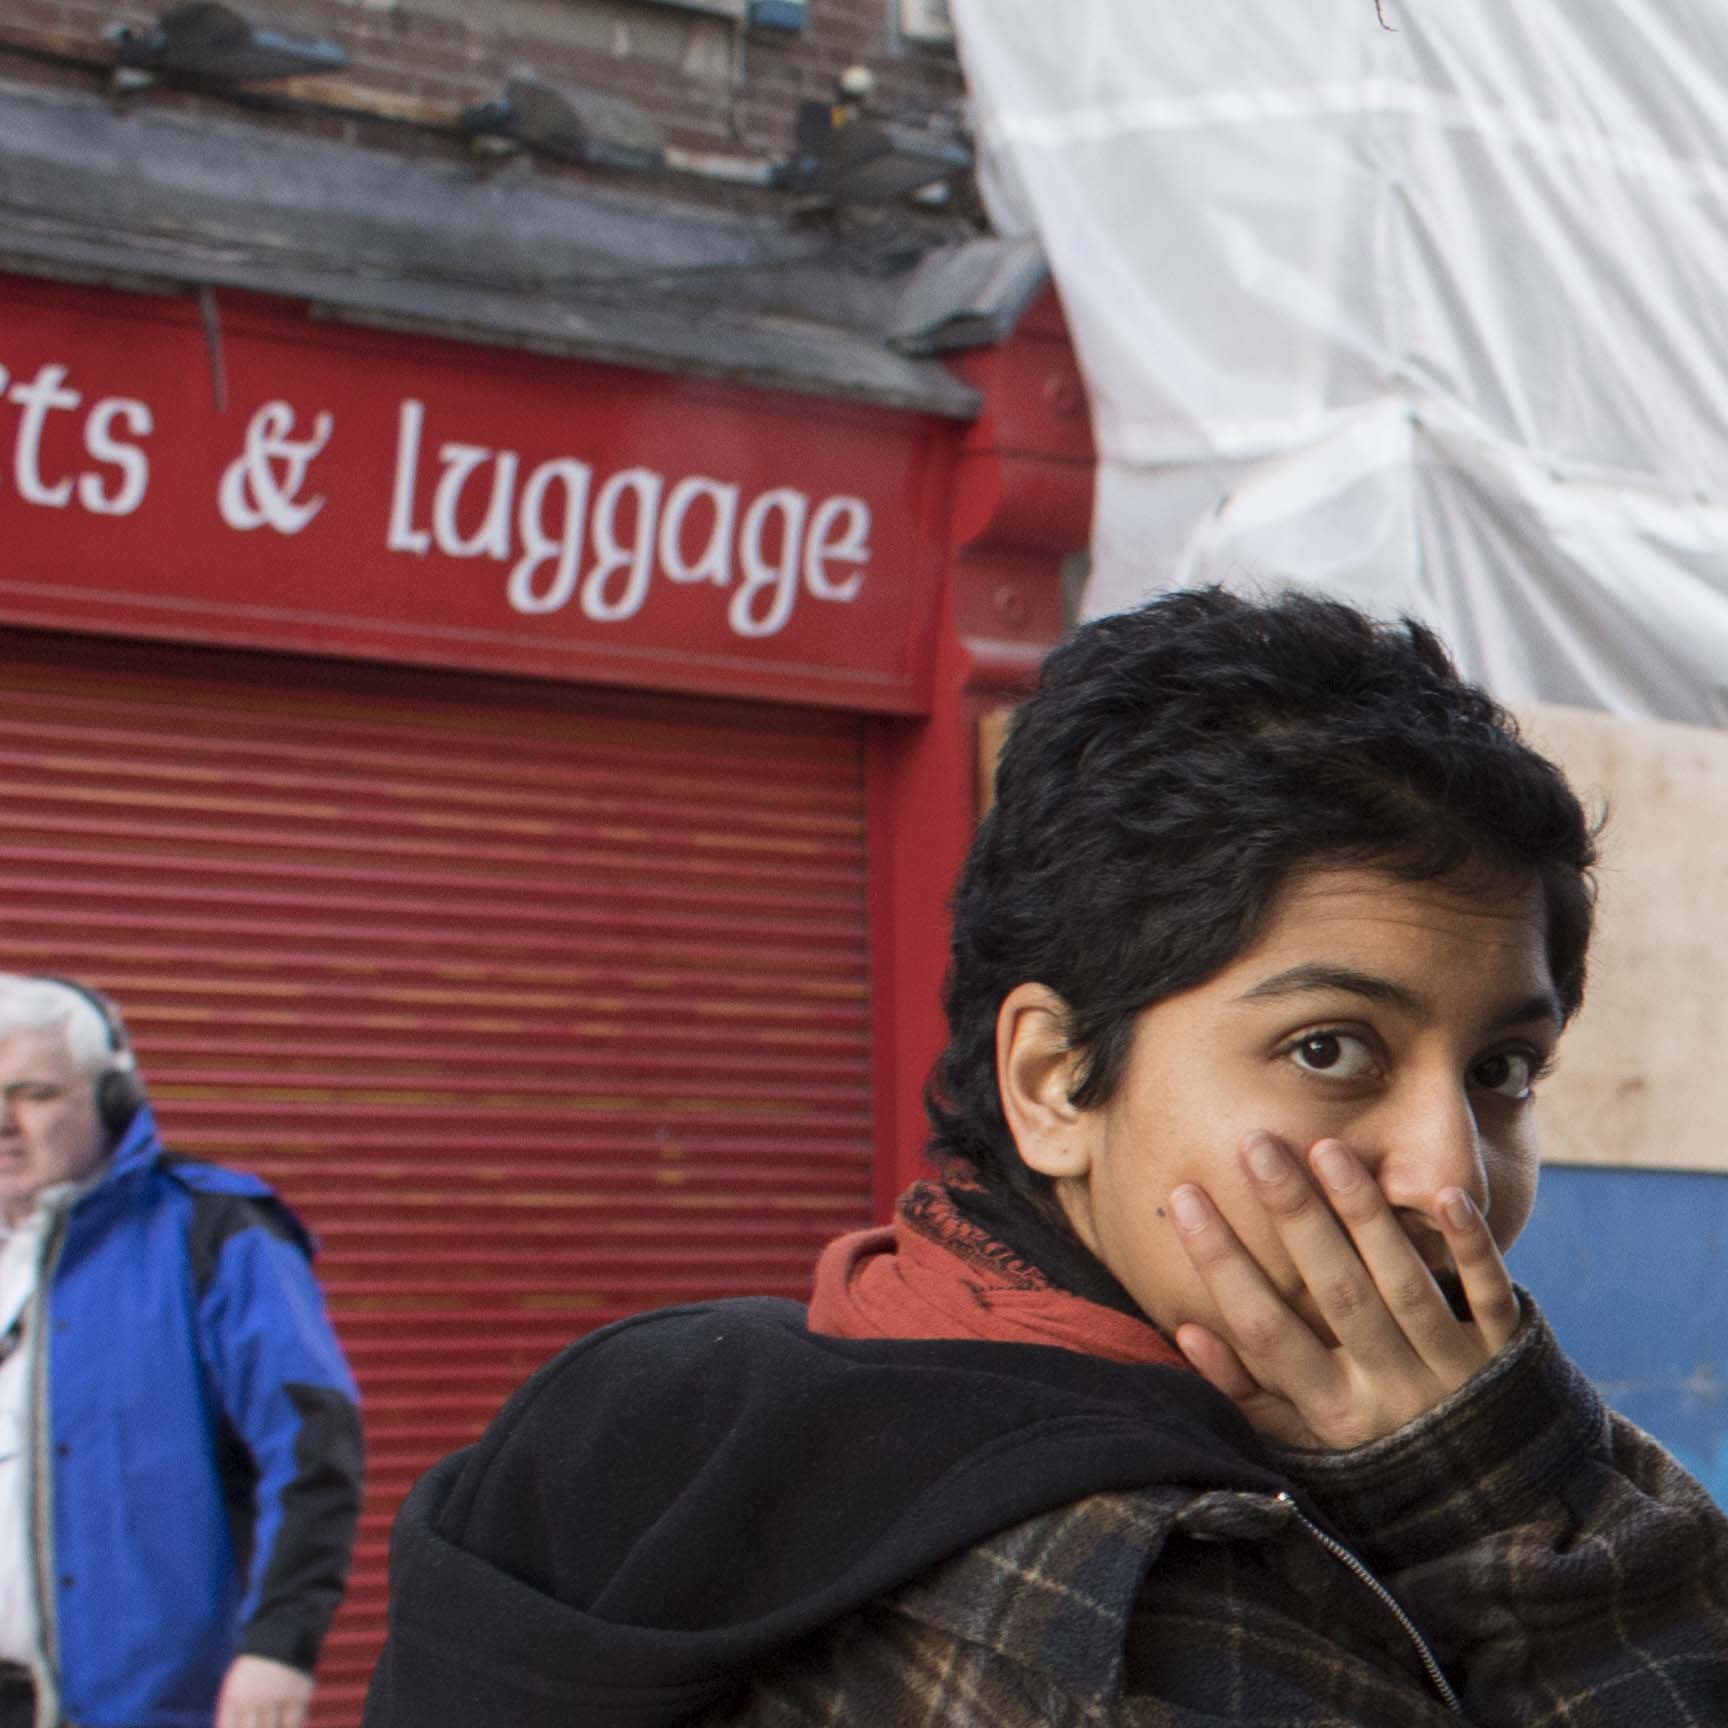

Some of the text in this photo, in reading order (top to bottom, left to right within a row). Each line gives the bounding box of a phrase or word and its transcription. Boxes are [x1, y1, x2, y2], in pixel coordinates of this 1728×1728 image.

[0, 363, 874, 639] ts & luggage
